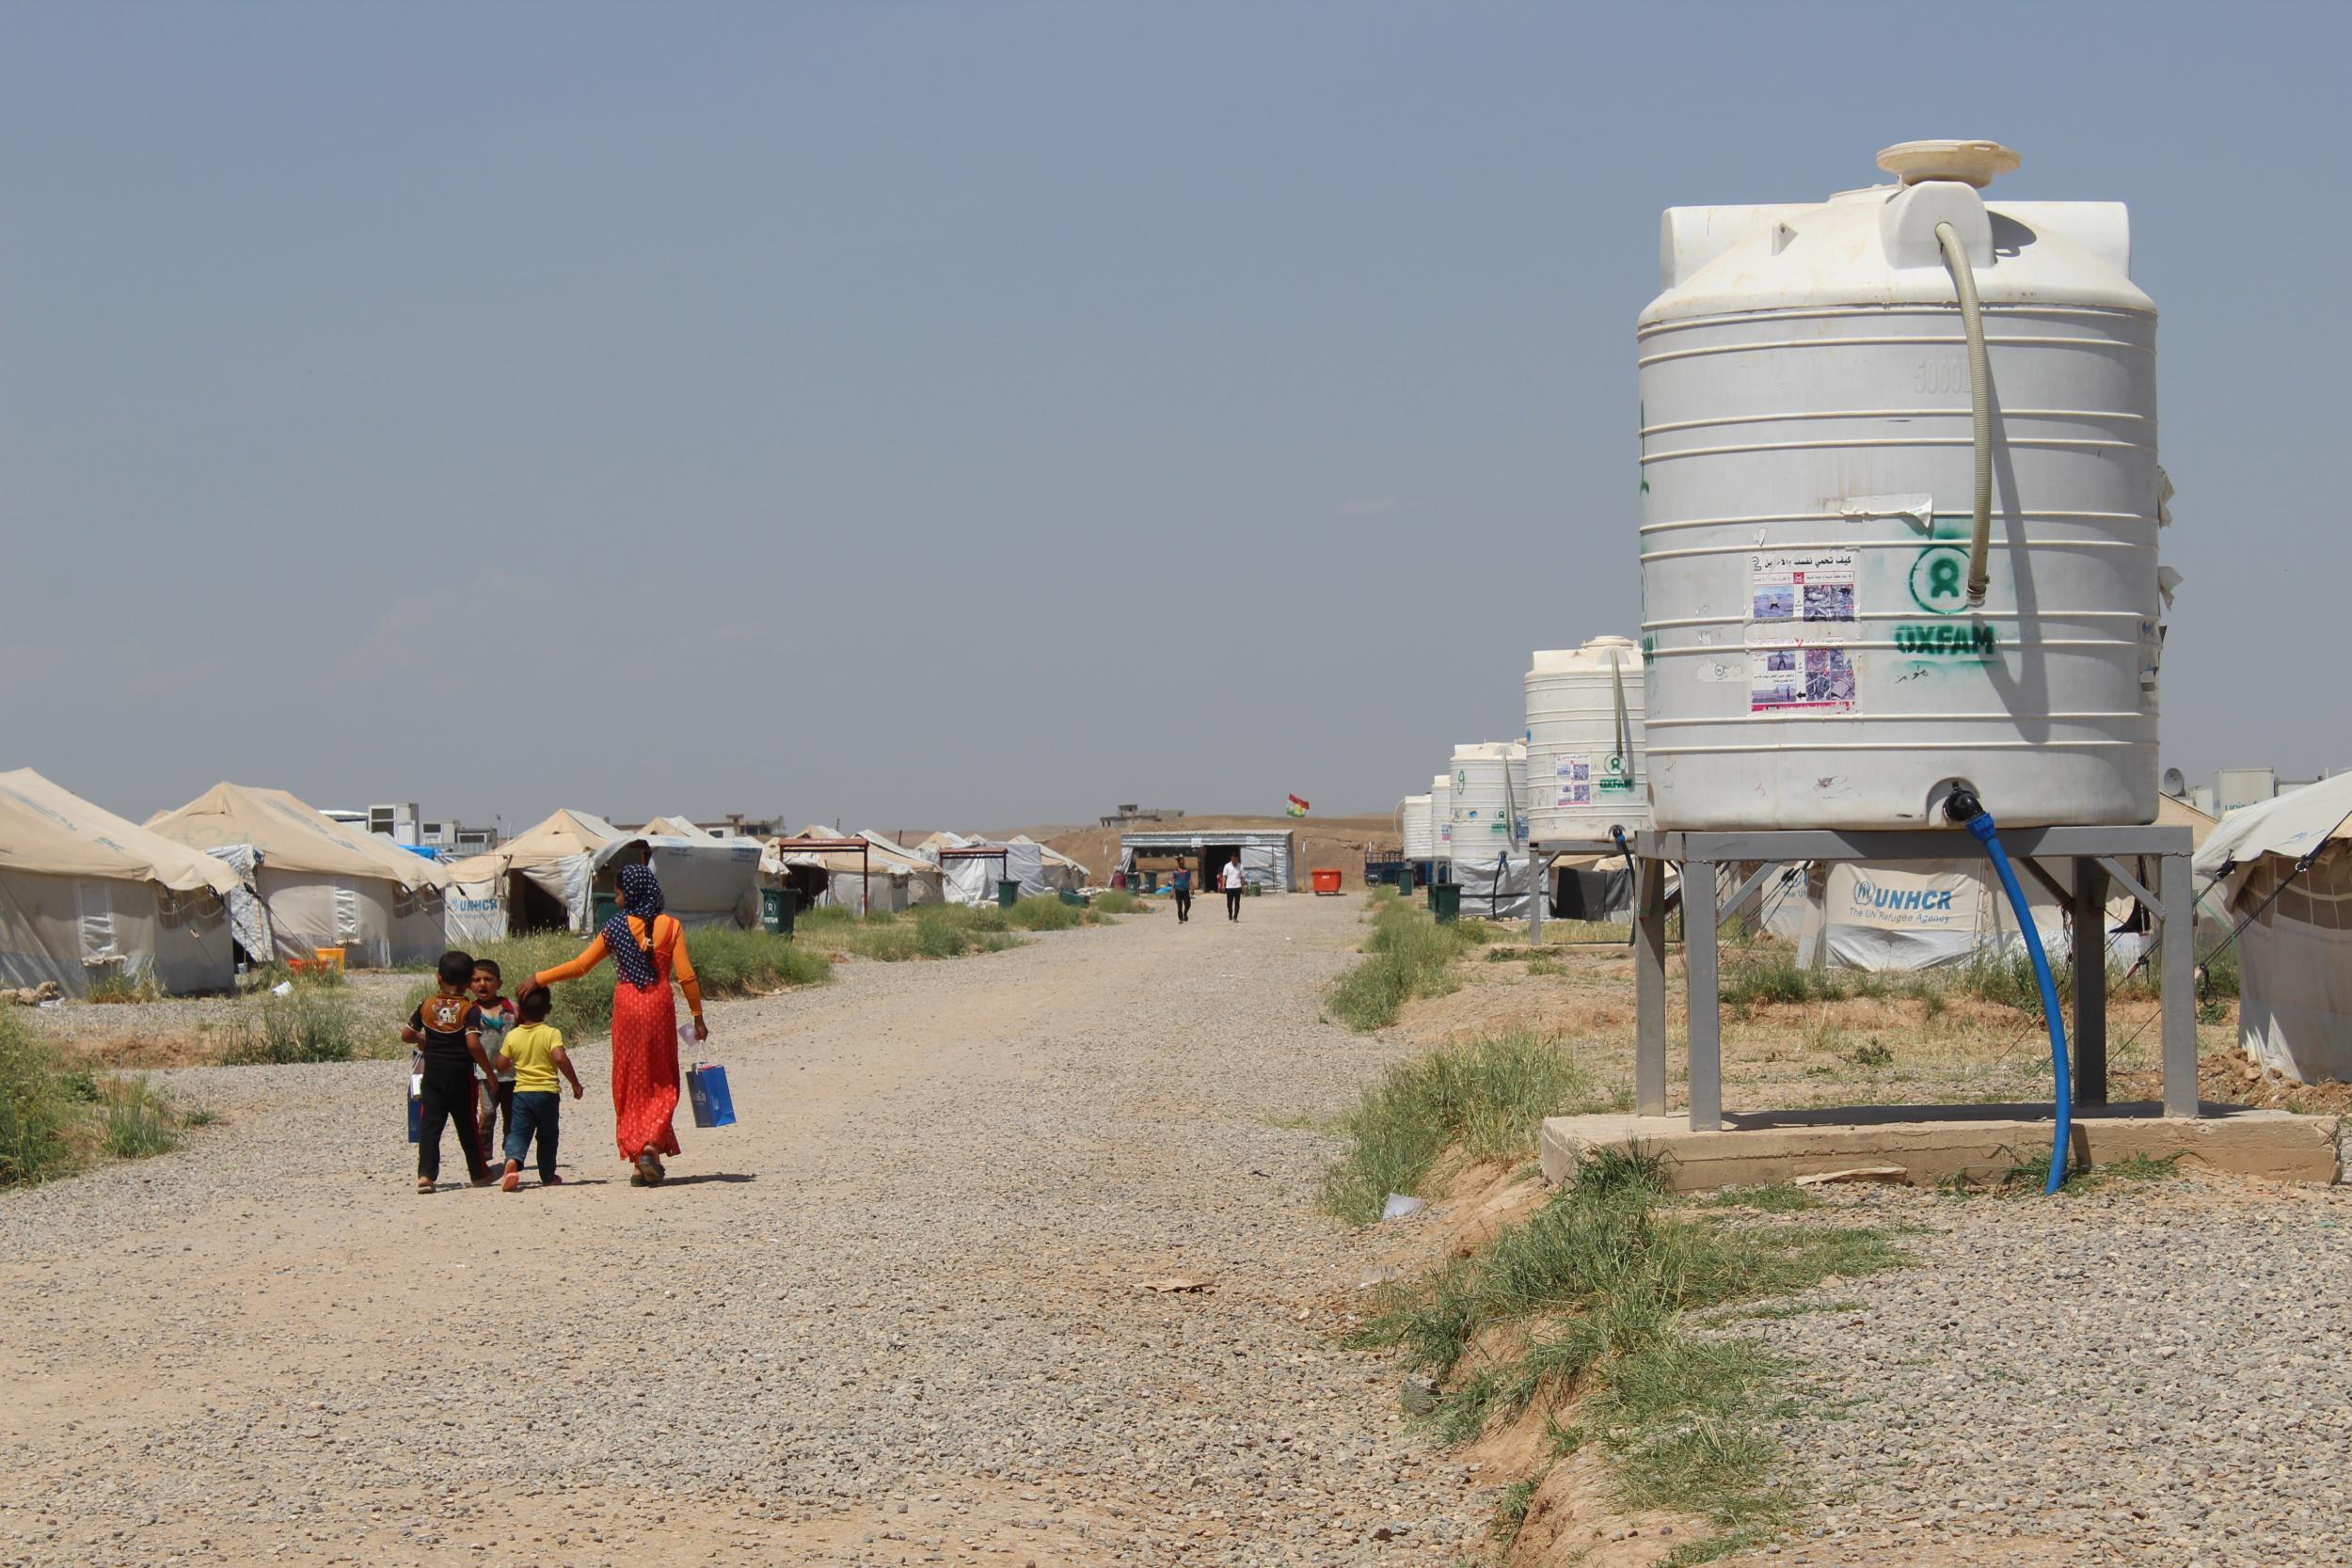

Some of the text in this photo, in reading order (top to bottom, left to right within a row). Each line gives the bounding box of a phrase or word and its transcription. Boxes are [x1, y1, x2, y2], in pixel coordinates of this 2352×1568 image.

[1895, 626, 1995, 655] OXFAM
[1599, 779, 1633, 789] OXFAM
[459, 898, 499, 911] UNHCR
[1874, 888, 1952, 910] UNHCR
[1850, 907, 1950, 924] The UN Refugee Agency
